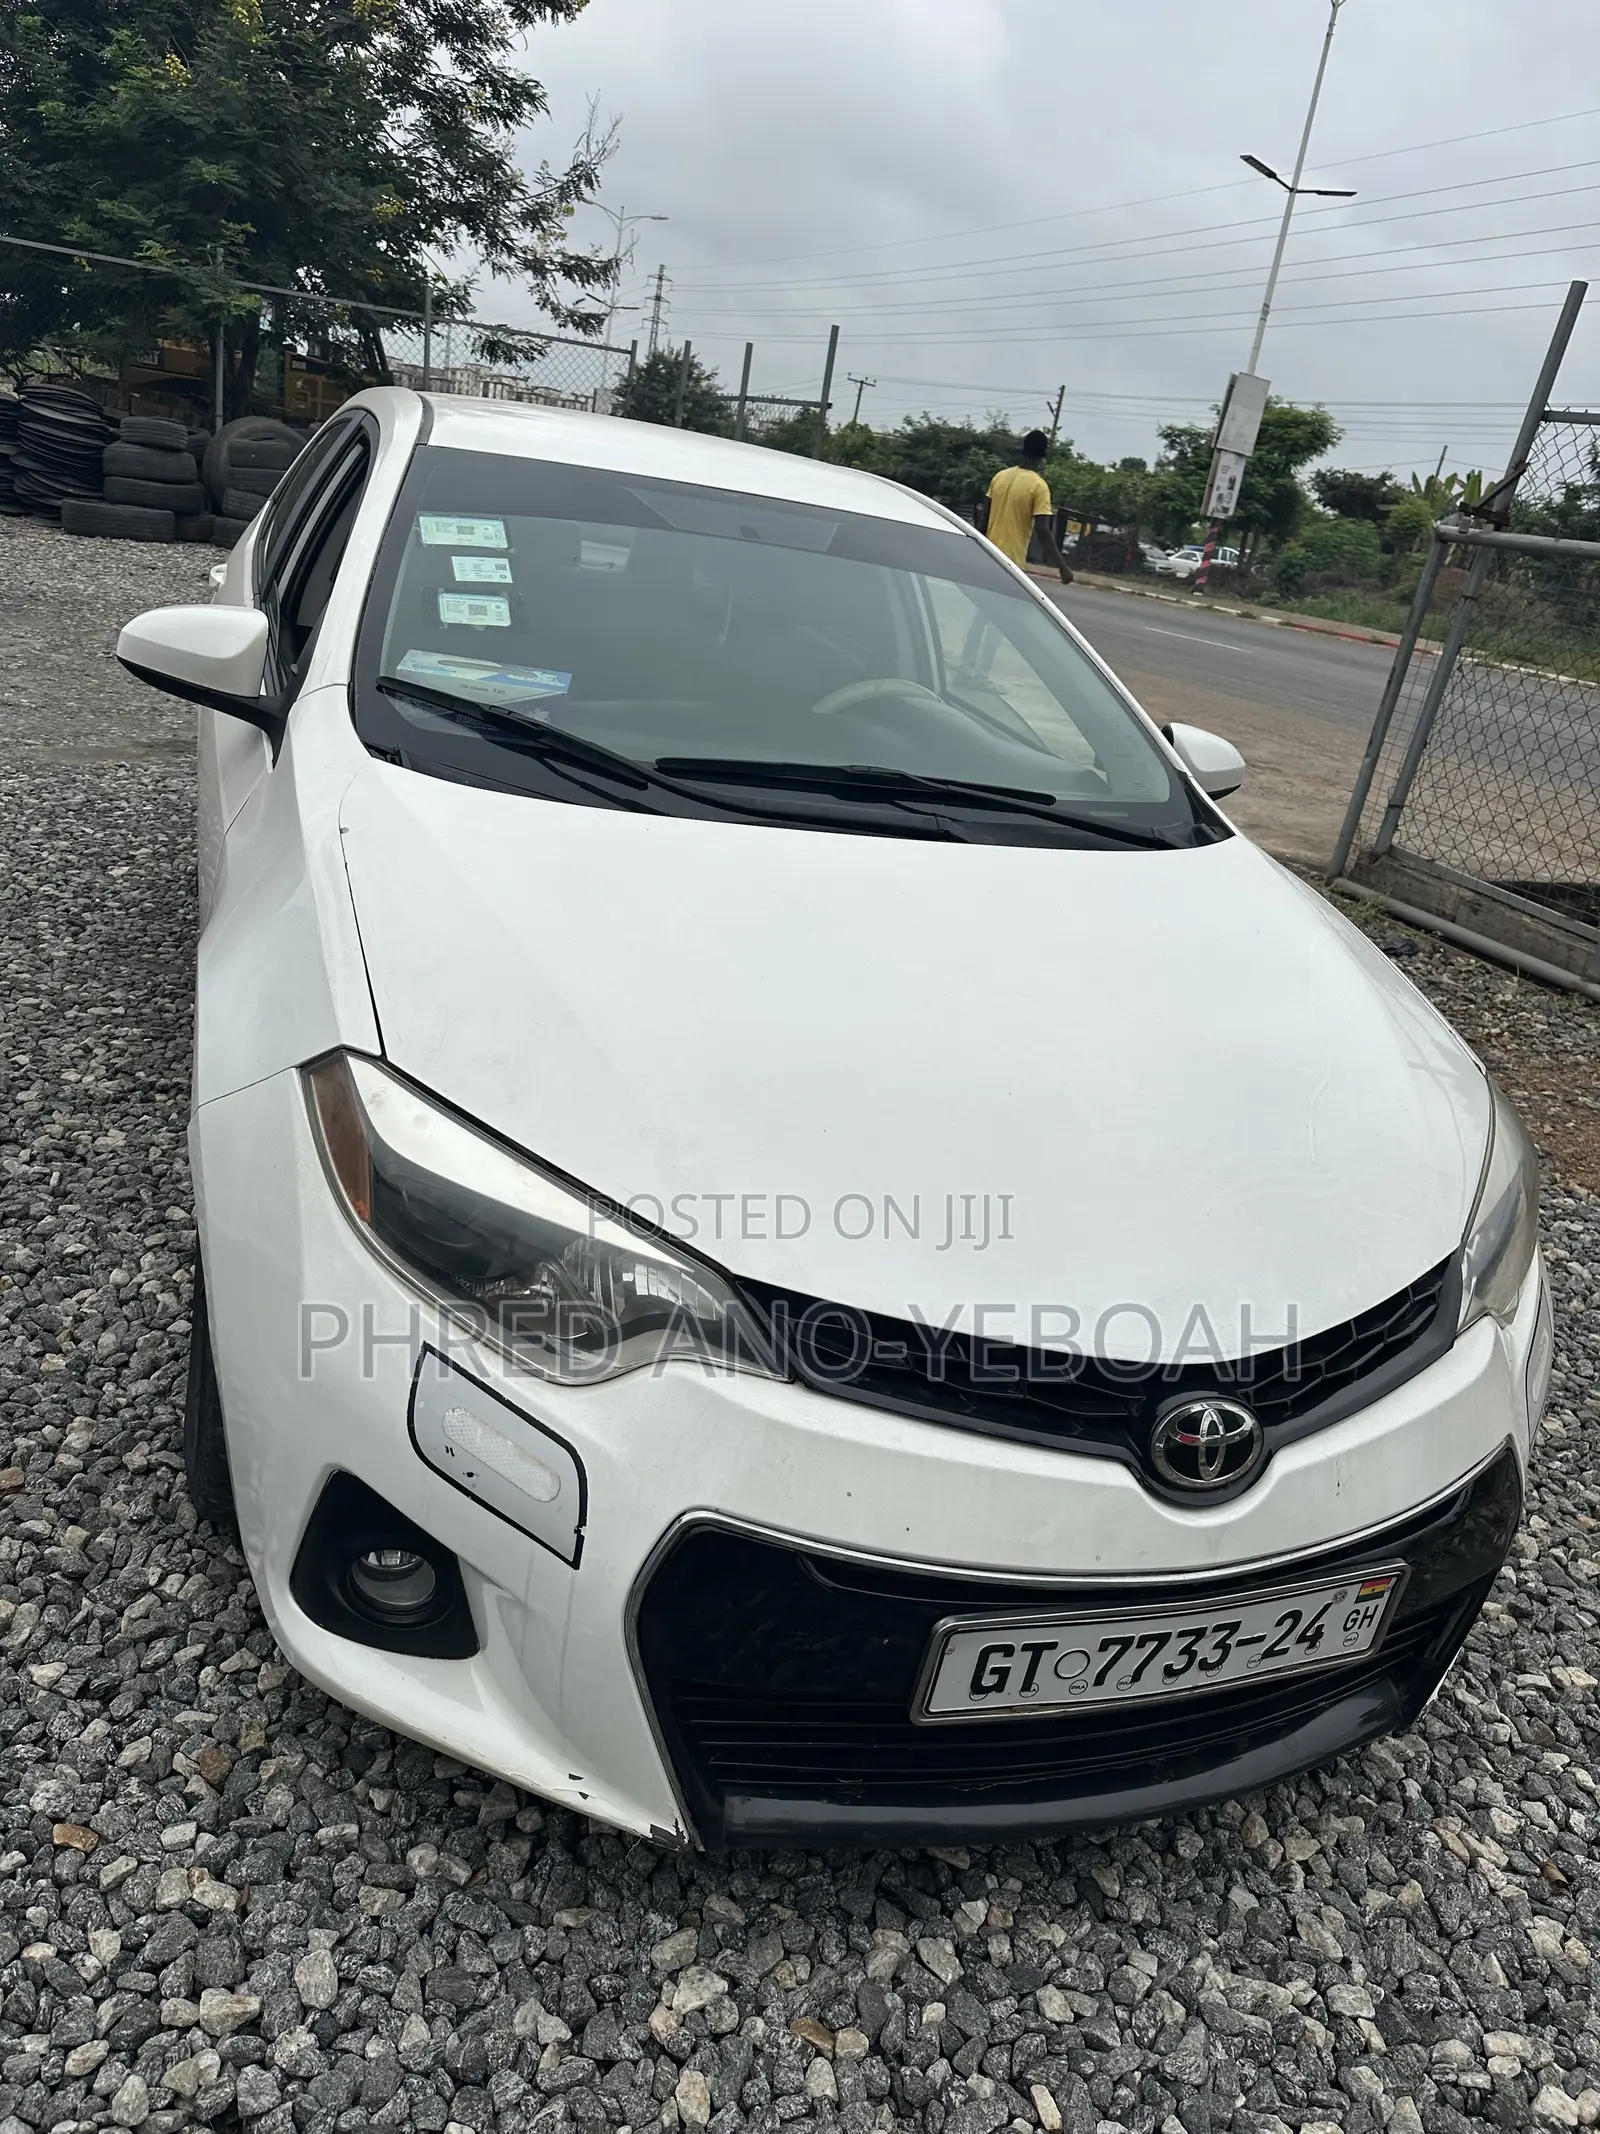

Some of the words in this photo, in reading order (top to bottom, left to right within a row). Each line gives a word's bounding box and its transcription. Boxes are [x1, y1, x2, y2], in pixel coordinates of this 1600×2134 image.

[970, 1640, 1059, 1694] GT
[1093, 1600, 1334, 1687] 7733-24
[1343, 1604, 1380, 1632] GH
